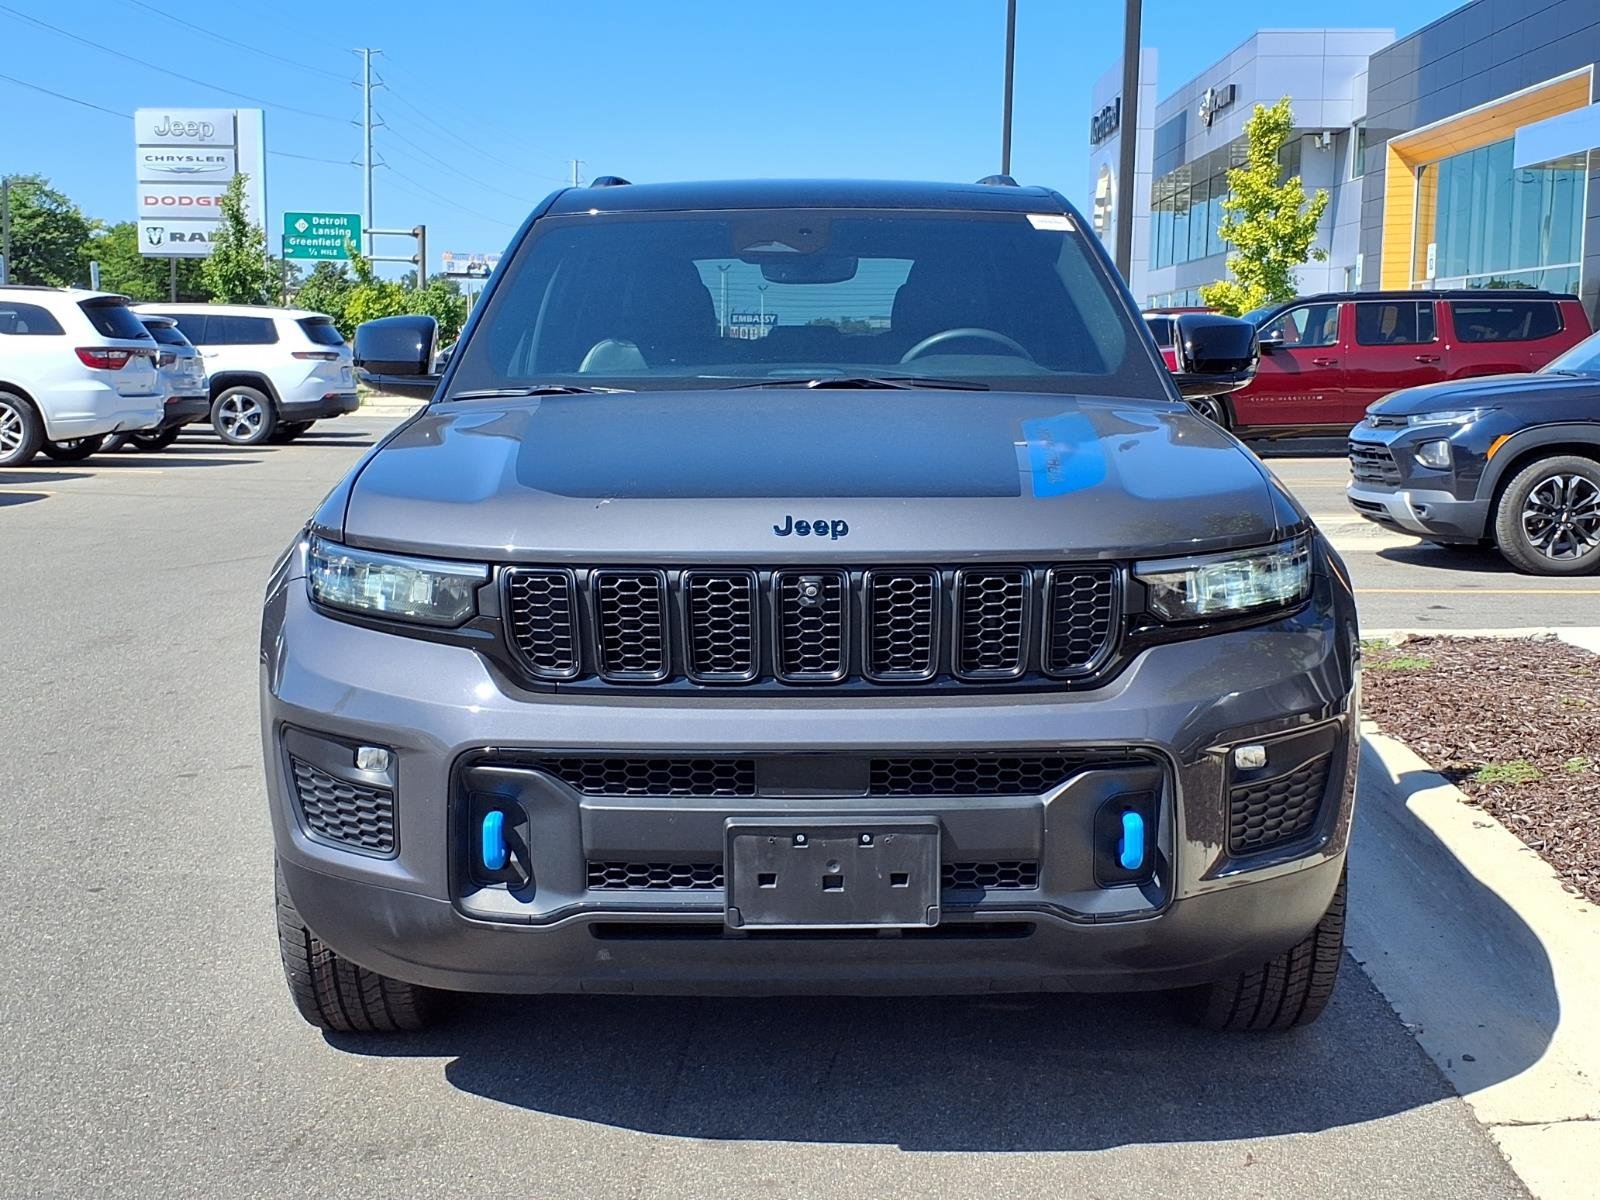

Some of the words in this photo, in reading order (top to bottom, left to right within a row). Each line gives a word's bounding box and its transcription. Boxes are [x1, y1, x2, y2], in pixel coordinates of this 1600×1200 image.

[154, 115, 215, 141] Jeep
[144, 155, 226, 163] CHRYSLER
[312, 216, 348, 226] Detroit
[312, 228, 352, 238] Lansing
[289, 238, 341, 247] Greenfield
[773, 515, 849, 540] Jeep
